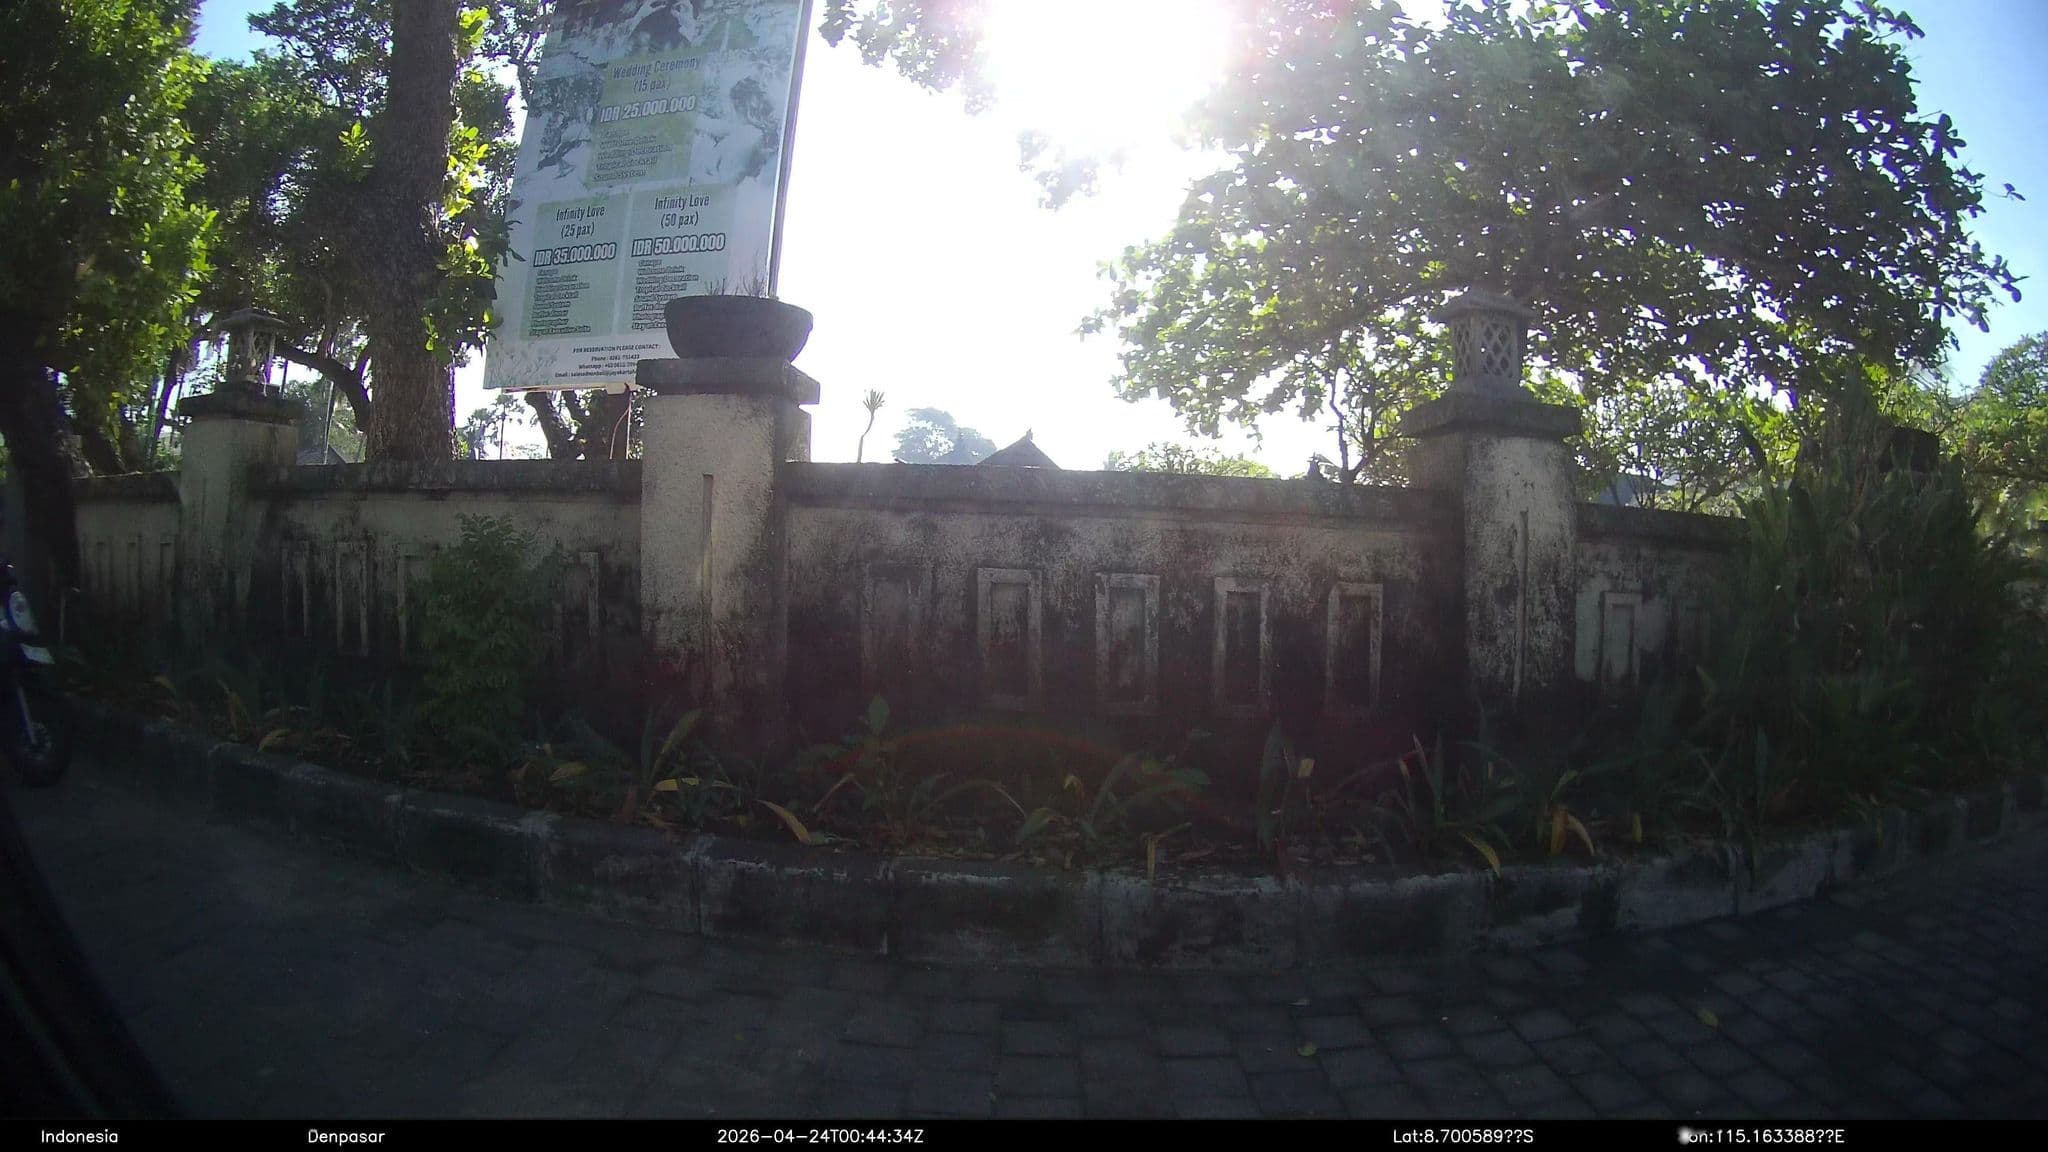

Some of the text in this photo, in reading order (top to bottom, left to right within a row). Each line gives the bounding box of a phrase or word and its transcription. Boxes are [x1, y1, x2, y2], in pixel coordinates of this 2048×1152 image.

[613, 58, 700, 79] Wedding Ceremony
[633, 77, 671, 94] (15 pax)
[600, 95, 696, 123] IDR 25.000.000
[655, 193, 710, 211] Infinity Love
[556, 204, 606, 223] Infinity Love
[661, 211, 699, 229] (50 pax)
[560, 221, 595, 240] (25 pax)
[631, 232, 726, 257] IDR 50.000.000
[533, 242, 617, 267] IDR 35.000.000
